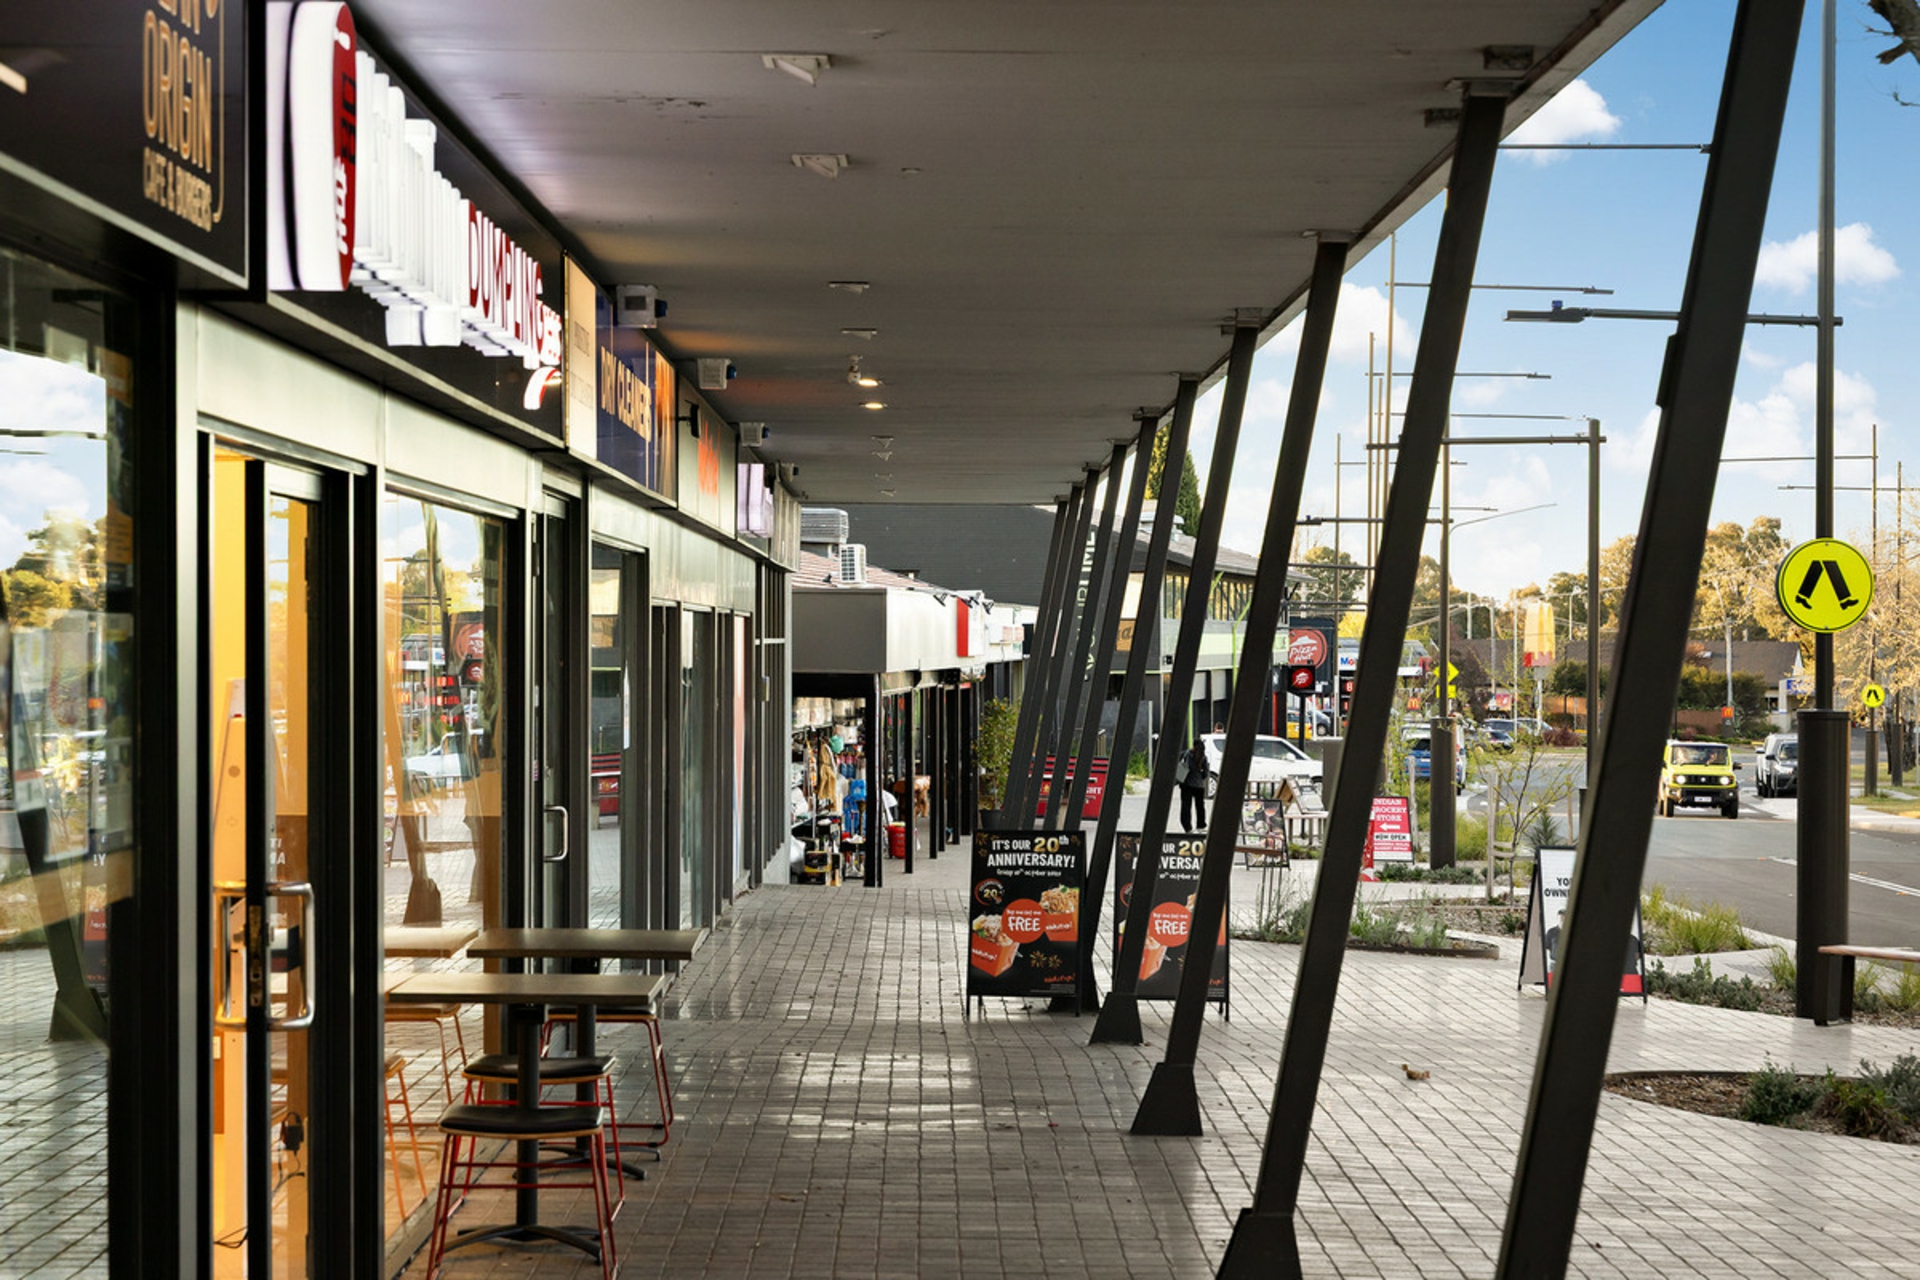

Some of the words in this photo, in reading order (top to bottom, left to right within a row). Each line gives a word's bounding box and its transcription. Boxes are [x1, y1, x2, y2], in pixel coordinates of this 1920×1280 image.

[143, 9, 213, 174] ORIGIN
[601, 345, 617, 416] DRY
[617, 360, 652, 443] CLEANERS
[1376, 814, 1402, 822] STORE
[992, 839, 1010, 851] IT'S
[1012, 839, 1031, 850] OUR
[1162, 842, 1175, 854] UR
[986, 853, 1076, 869] ANNIVERSARY!
[1556, 877, 1571, 887] YO
[1007, 916, 1041, 932] FREE
[1154, 919, 1188, 936] FREE
